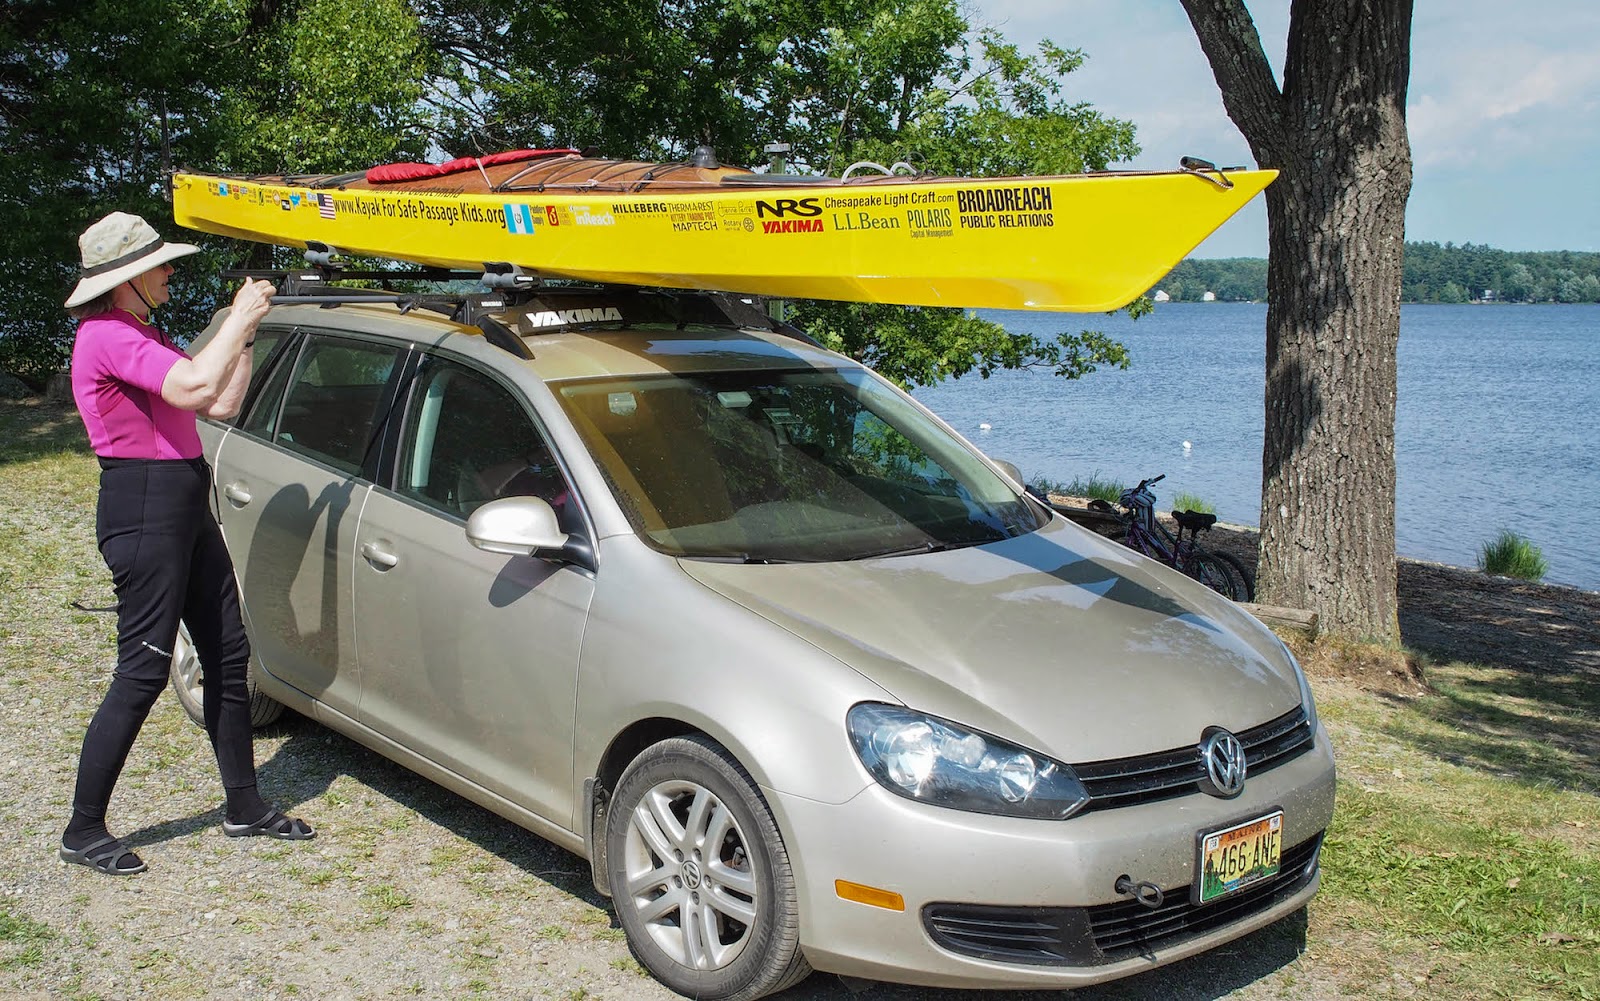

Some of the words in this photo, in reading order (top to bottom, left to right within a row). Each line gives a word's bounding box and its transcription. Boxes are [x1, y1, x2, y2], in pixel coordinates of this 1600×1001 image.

[612, 202, 667, 214] HILLEBERG
[755, 198, 823, 218] NRS
[825, 194, 882, 209] Chesapeake
[884, 193, 909, 207] Light
[911, 191, 954, 205] Craft.com
[957, 187, 1052, 213] BROADREACH
[334, 197, 381, 220] www.Kayak
[382, 198, 396, 215] For
[397, 199, 418, 219] Safe
[419, 200, 458, 226] Passage
[459, 202, 507, 229] Kids.org
[833, 212, 900, 231] L.L.Bean
[907, 208, 952, 229] POLARIS
[960, 214, 996, 229] PUBLIC
[998, 213, 1054, 228] RELATIONS
[672, 221, 718, 232] MAPTECH
[762, 219, 824, 234] YAKIMA
[525, 307, 623, 328] YAKIMA
[1219, 841, 1247, 879] 466
